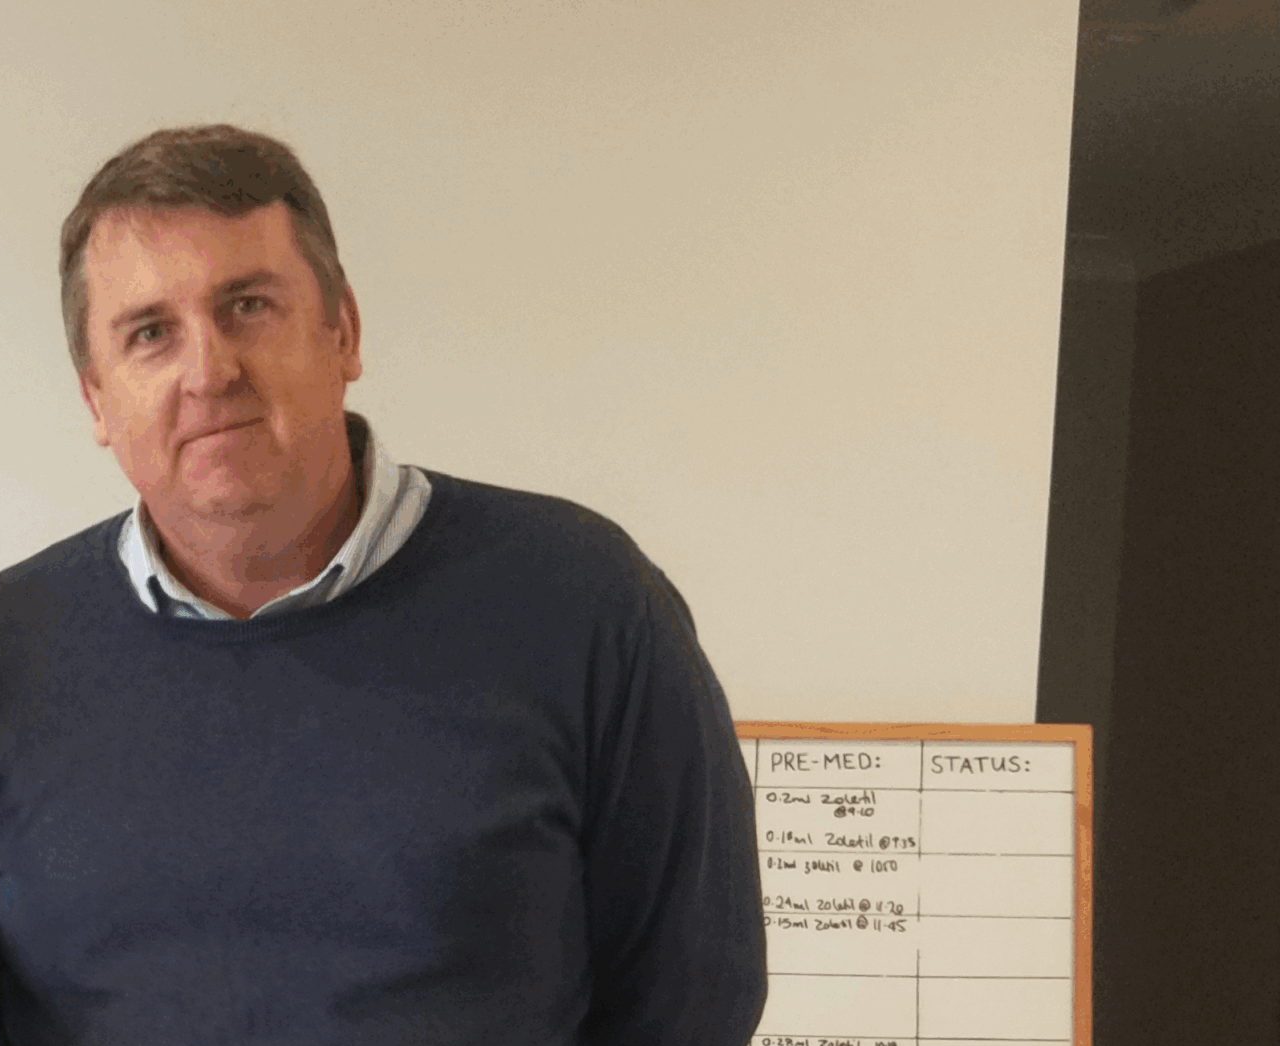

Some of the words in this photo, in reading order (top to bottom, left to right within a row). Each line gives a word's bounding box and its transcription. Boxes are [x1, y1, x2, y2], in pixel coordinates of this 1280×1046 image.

[770, 751, 881, 773] PRE-MED:
[931, 755, 1031, 774] STATUS:
[859, 899, 871, 912] @
[856, 914, 868, 929] @
